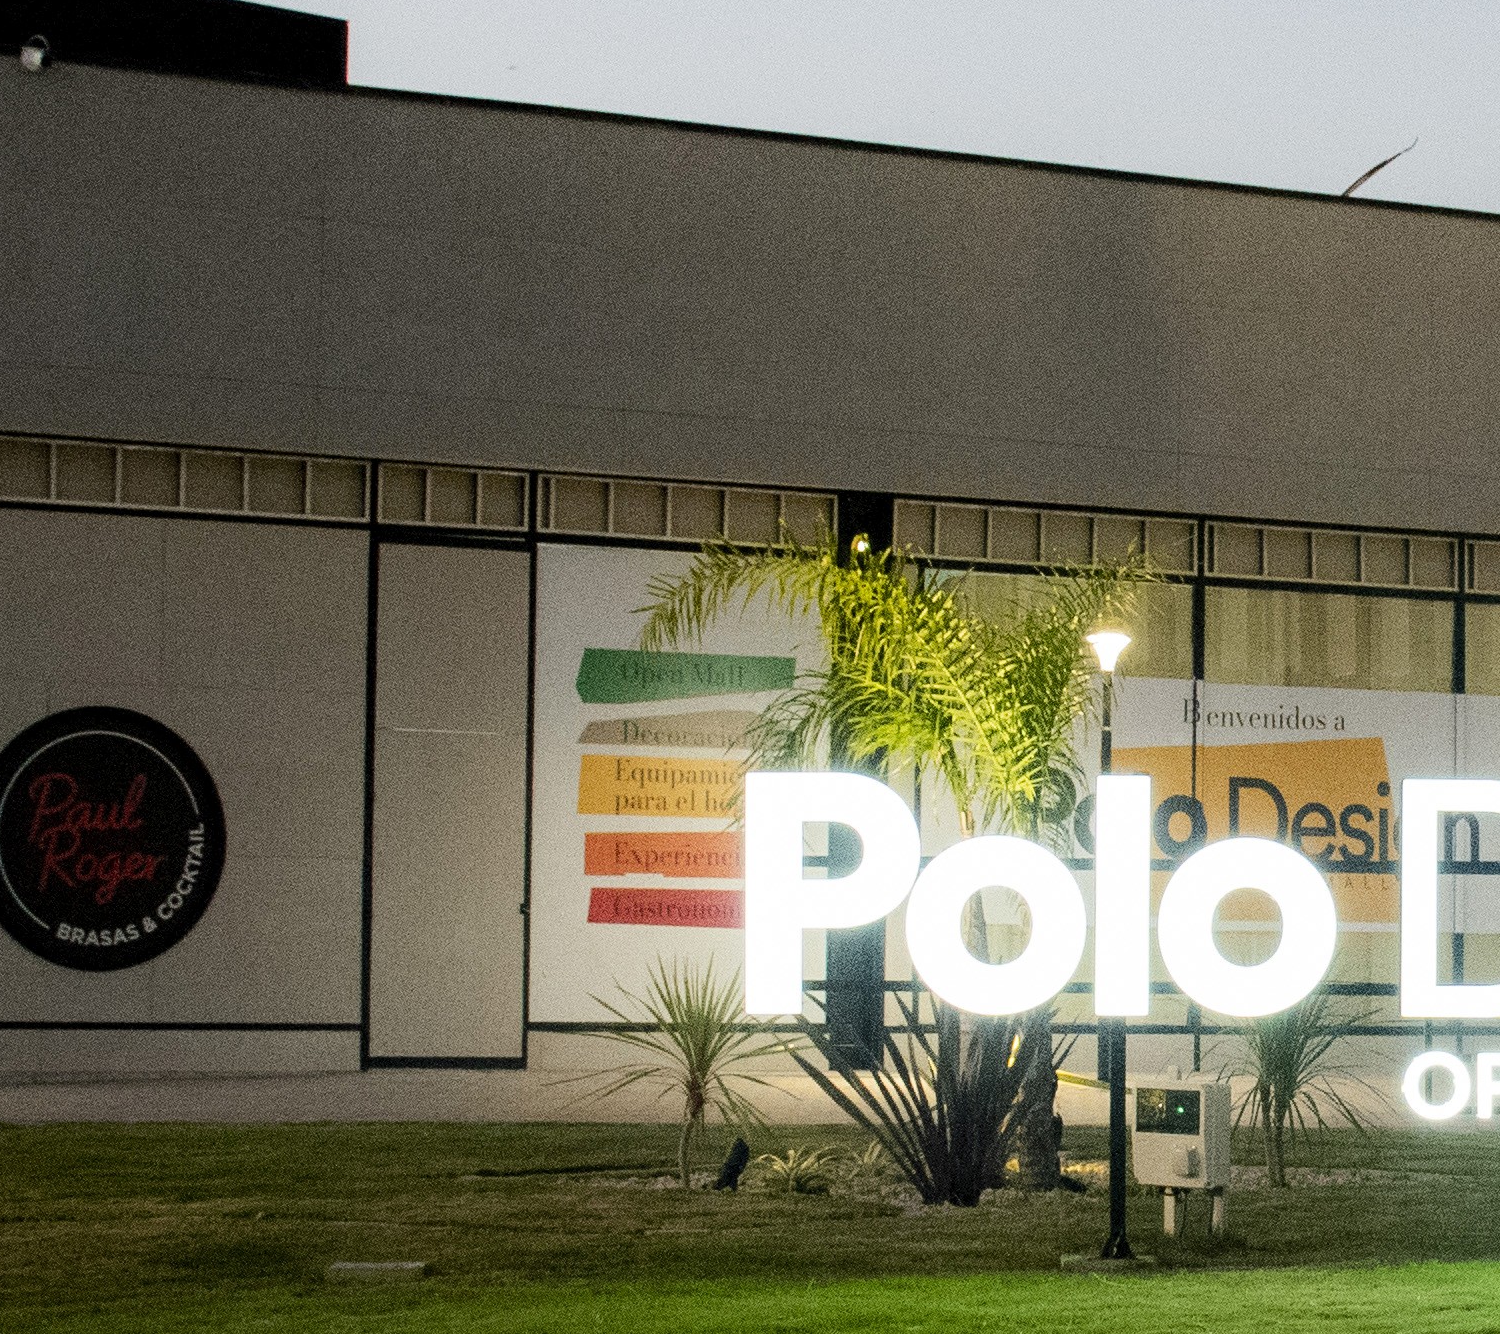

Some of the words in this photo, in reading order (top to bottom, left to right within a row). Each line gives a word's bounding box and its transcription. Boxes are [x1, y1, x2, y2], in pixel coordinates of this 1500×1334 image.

[1333, 715, 1346, 731] a
[28, 772, 148, 844] Paul
[614, 794, 667, 815] para
[675, 789, 695, 811] el
[1228, 774, 1480, 867] Desin
[38, 825, 167, 905] Roger
[55, 922, 140, 947] BRASAS
[142, 916, 158, 933] &
[157, 822, 205, 921] COCKTAIL
[745, 770, 1338, 1017] Polo
